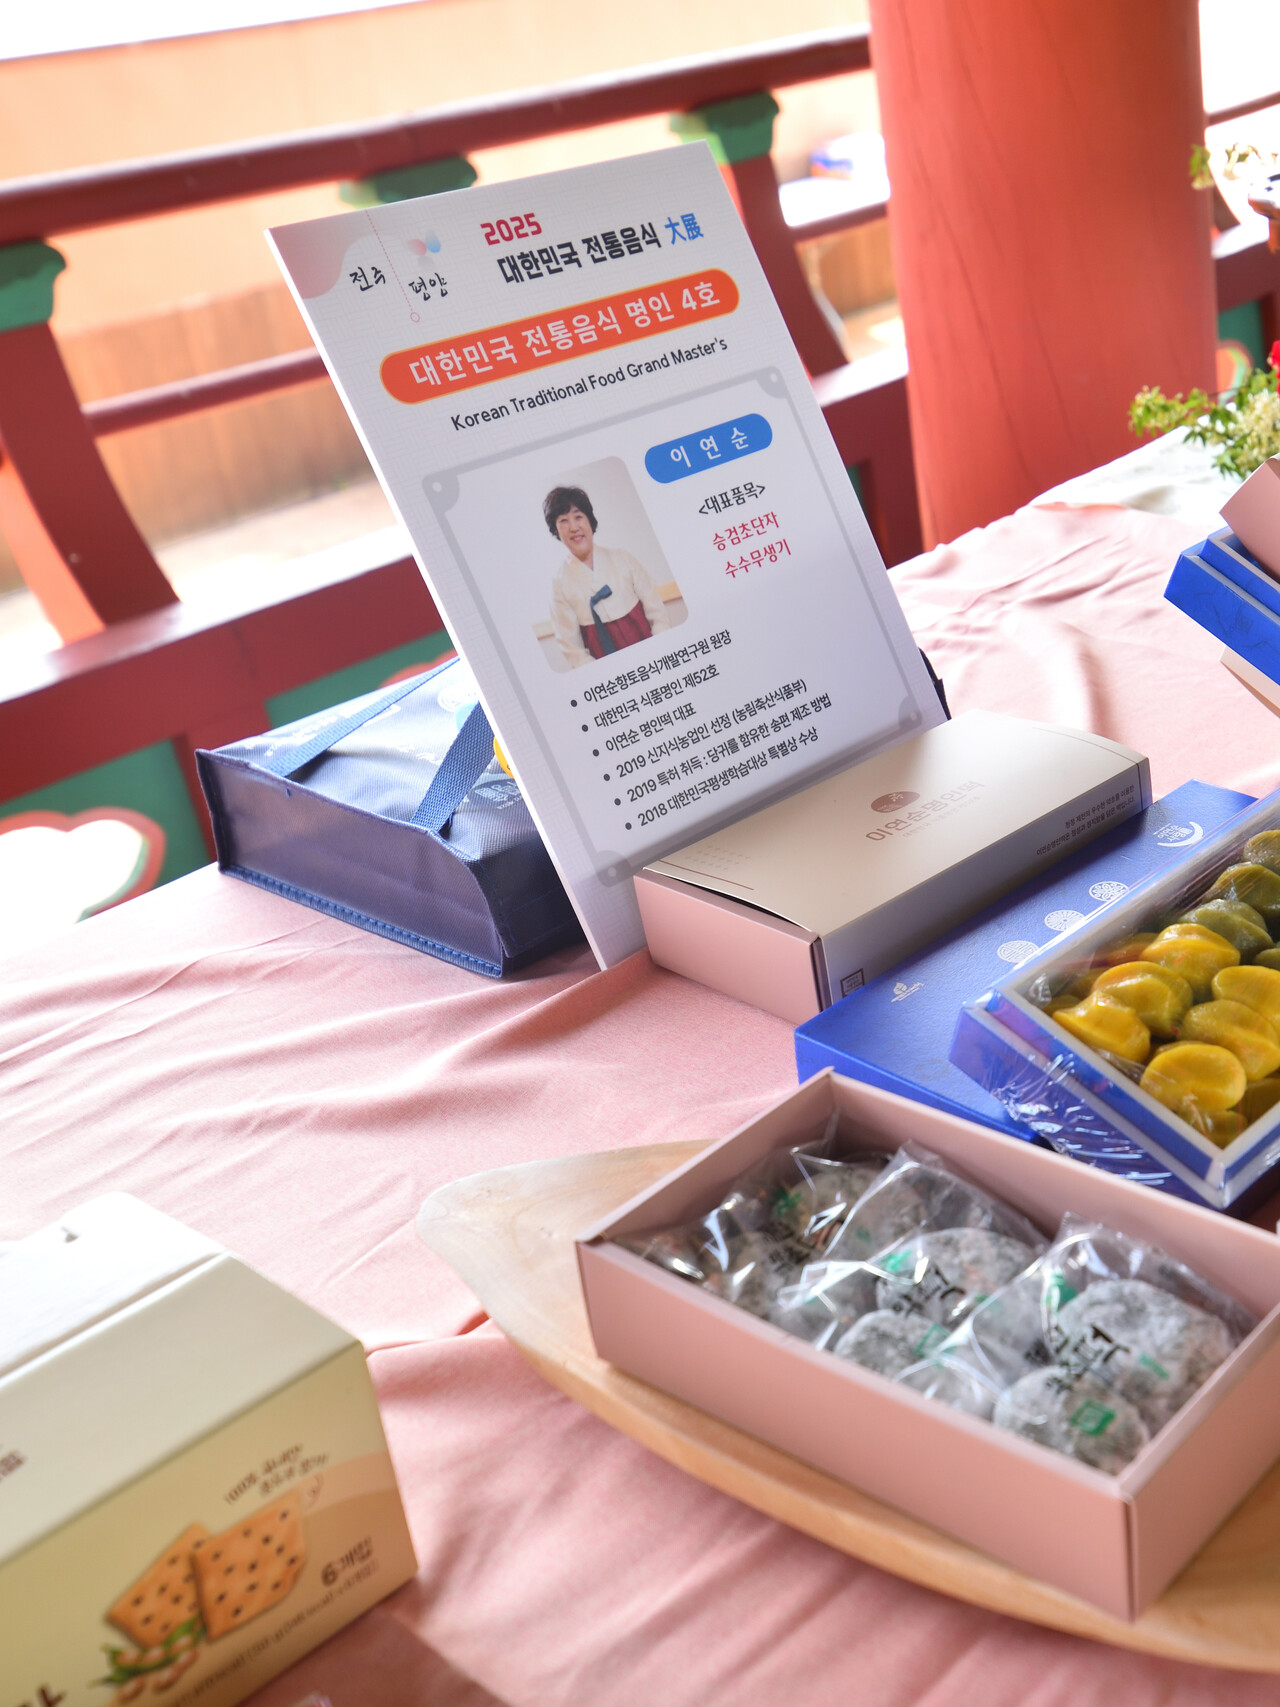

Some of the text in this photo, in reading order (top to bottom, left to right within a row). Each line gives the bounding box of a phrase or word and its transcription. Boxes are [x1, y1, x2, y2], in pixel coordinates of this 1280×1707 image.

[480, 212, 542, 246] 2025
[497, 212, 704, 283] 대한민국 전통음식 大展
[350, 266, 386, 291] 전주
[408, 281, 721, 387] 대한민국 전통음식 명인 4호
[450, 337, 728, 432] Korean Traditional Food Grand Master's
[698, 481, 766, 515] <대표품목>
[712, 511, 779, 551] 승검초단자
[725, 539, 791, 578] 수수무생기
[584, 629, 732, 703] 이연순향토음식개발연구원 원장
[594, 663, 720, 727] 대한민국 식품명인 제52호
[605, 702, 696, 751] 이연순 명인떡 대표
[616, 678, 807, 778] 2019 신지식농업인 선정 (농림축산식품부)
[627, 779, 657, 803] 2019
[657, 766, 681, 787] 특허
[680, 755, 703, 776] 취득
[707, 738, 740, 763] 당귀를
[738, 723, 770, 748] 함유한
[770, 712, 791, 732] 송편
[789, 701, 811, 721] 제조
[810, 692, 832, 713] 방법
[637, 726, 819, 827] 2018 대한민국평생학습대상 특별상 수상
[865, 780, 987, 842] 이연순명인떡
